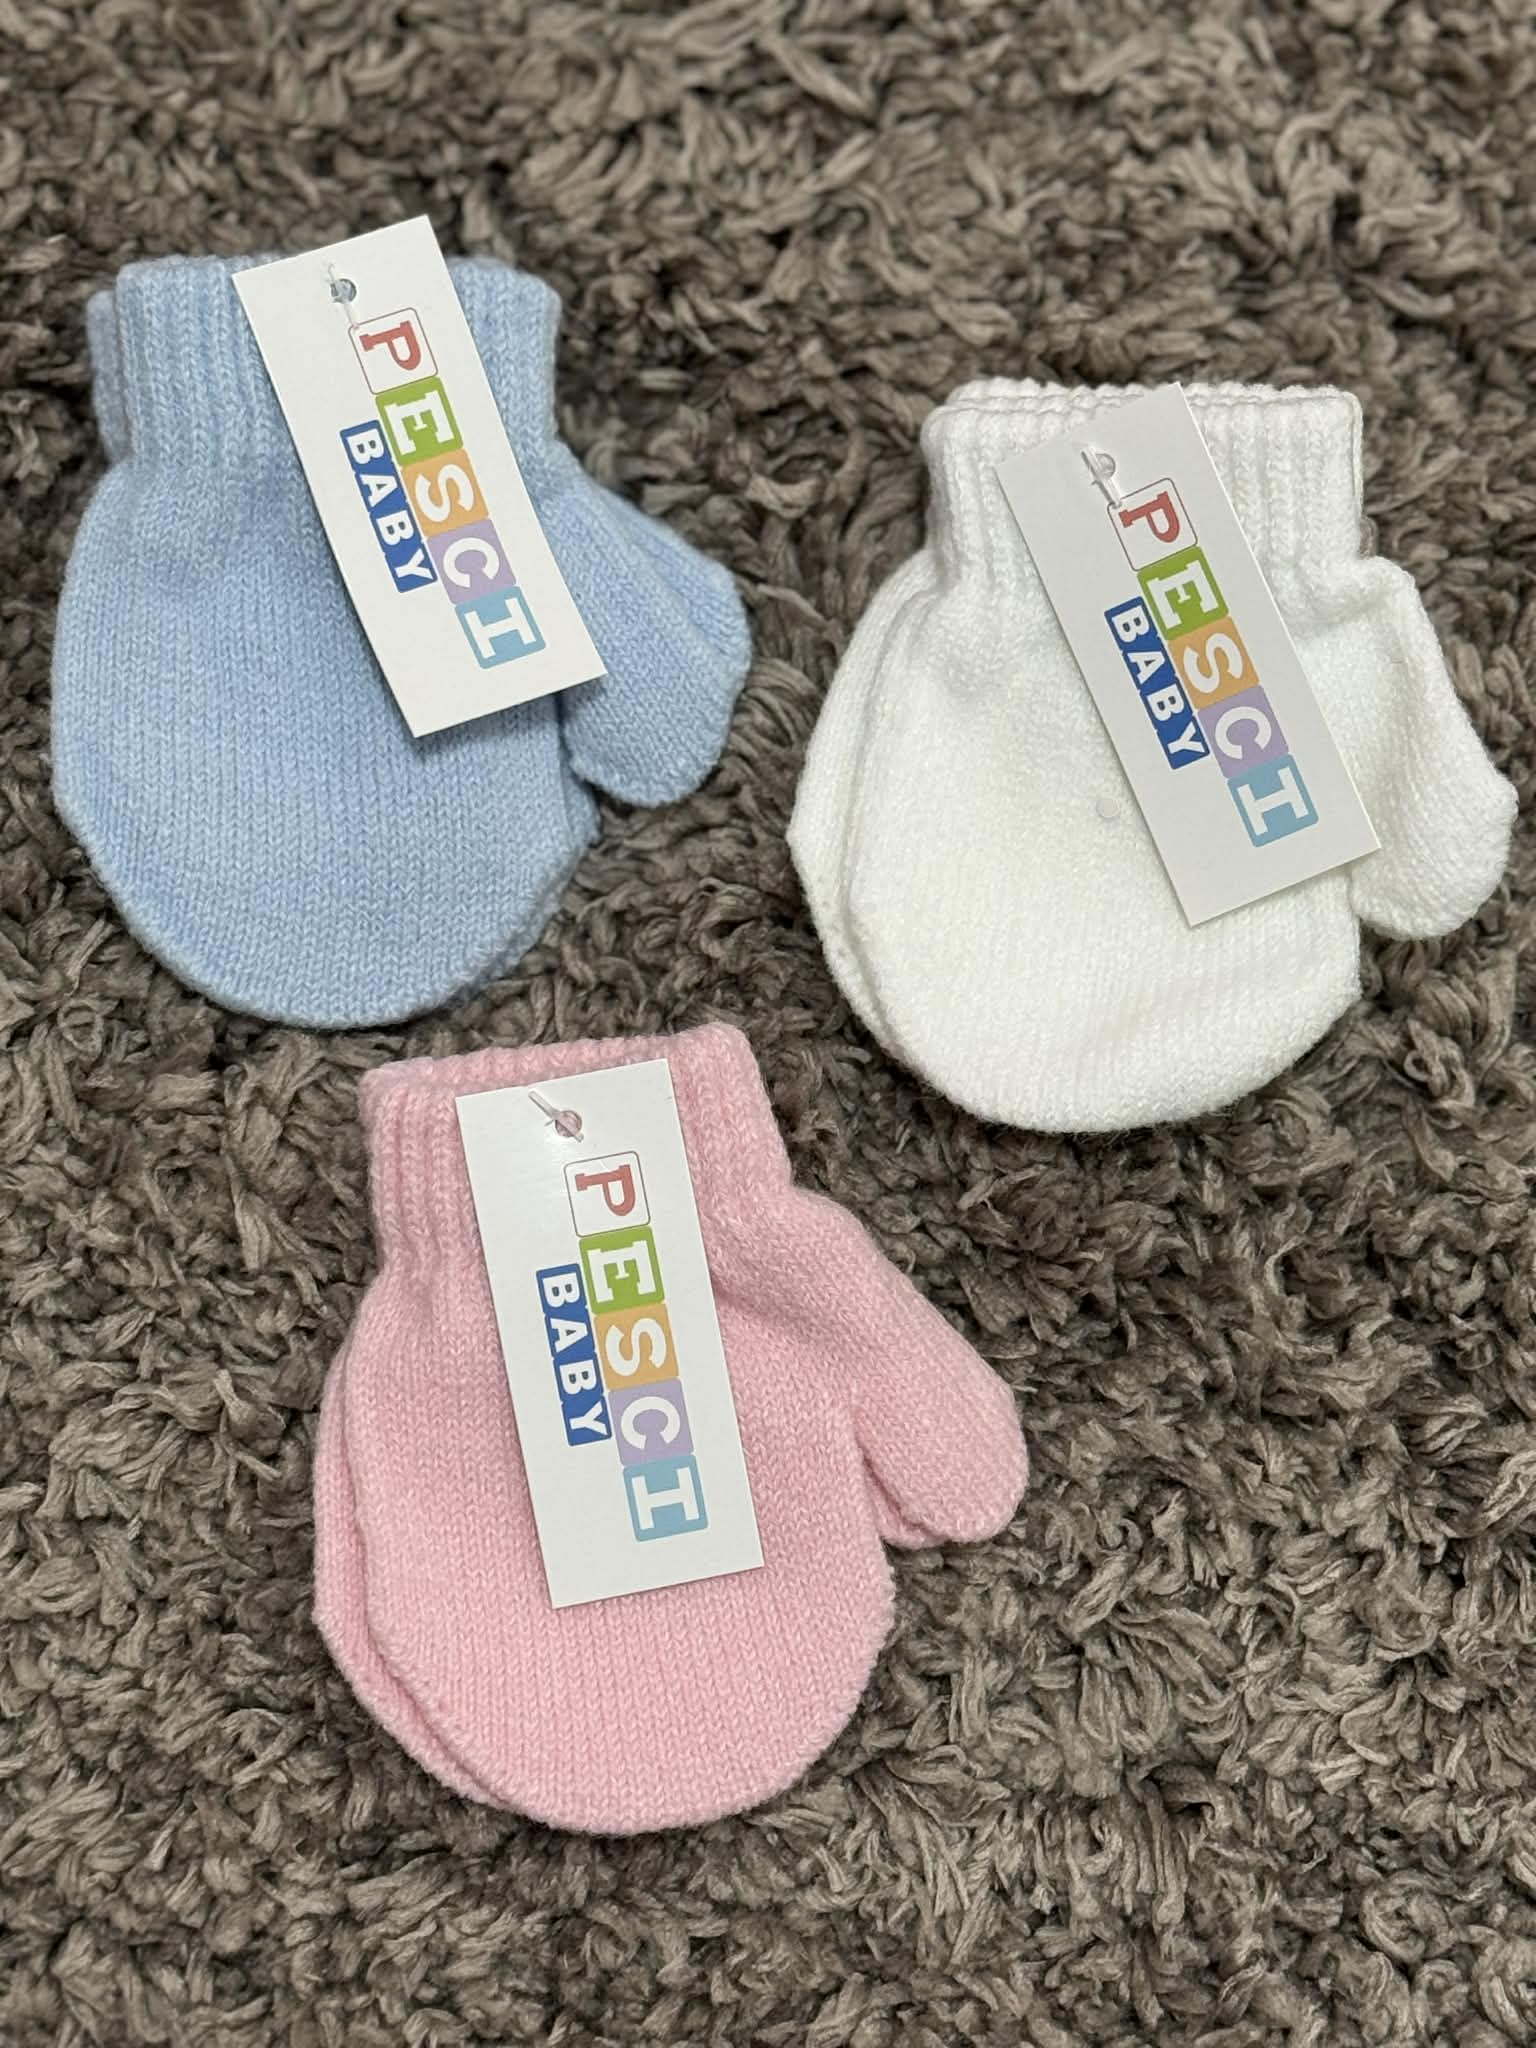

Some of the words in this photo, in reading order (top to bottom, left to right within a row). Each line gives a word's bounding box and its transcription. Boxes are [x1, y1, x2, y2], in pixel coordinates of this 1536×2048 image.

[347, 429, 435, 582] BABY
[359, 320, 537, 658] PESCI
[1111, 606, 1205, 757] BABY
[1118, 490, 1309, 835] PESCI
[542, 1273, 608, 1439] BABY
[575, 1164, 700, 1530] PESCI
